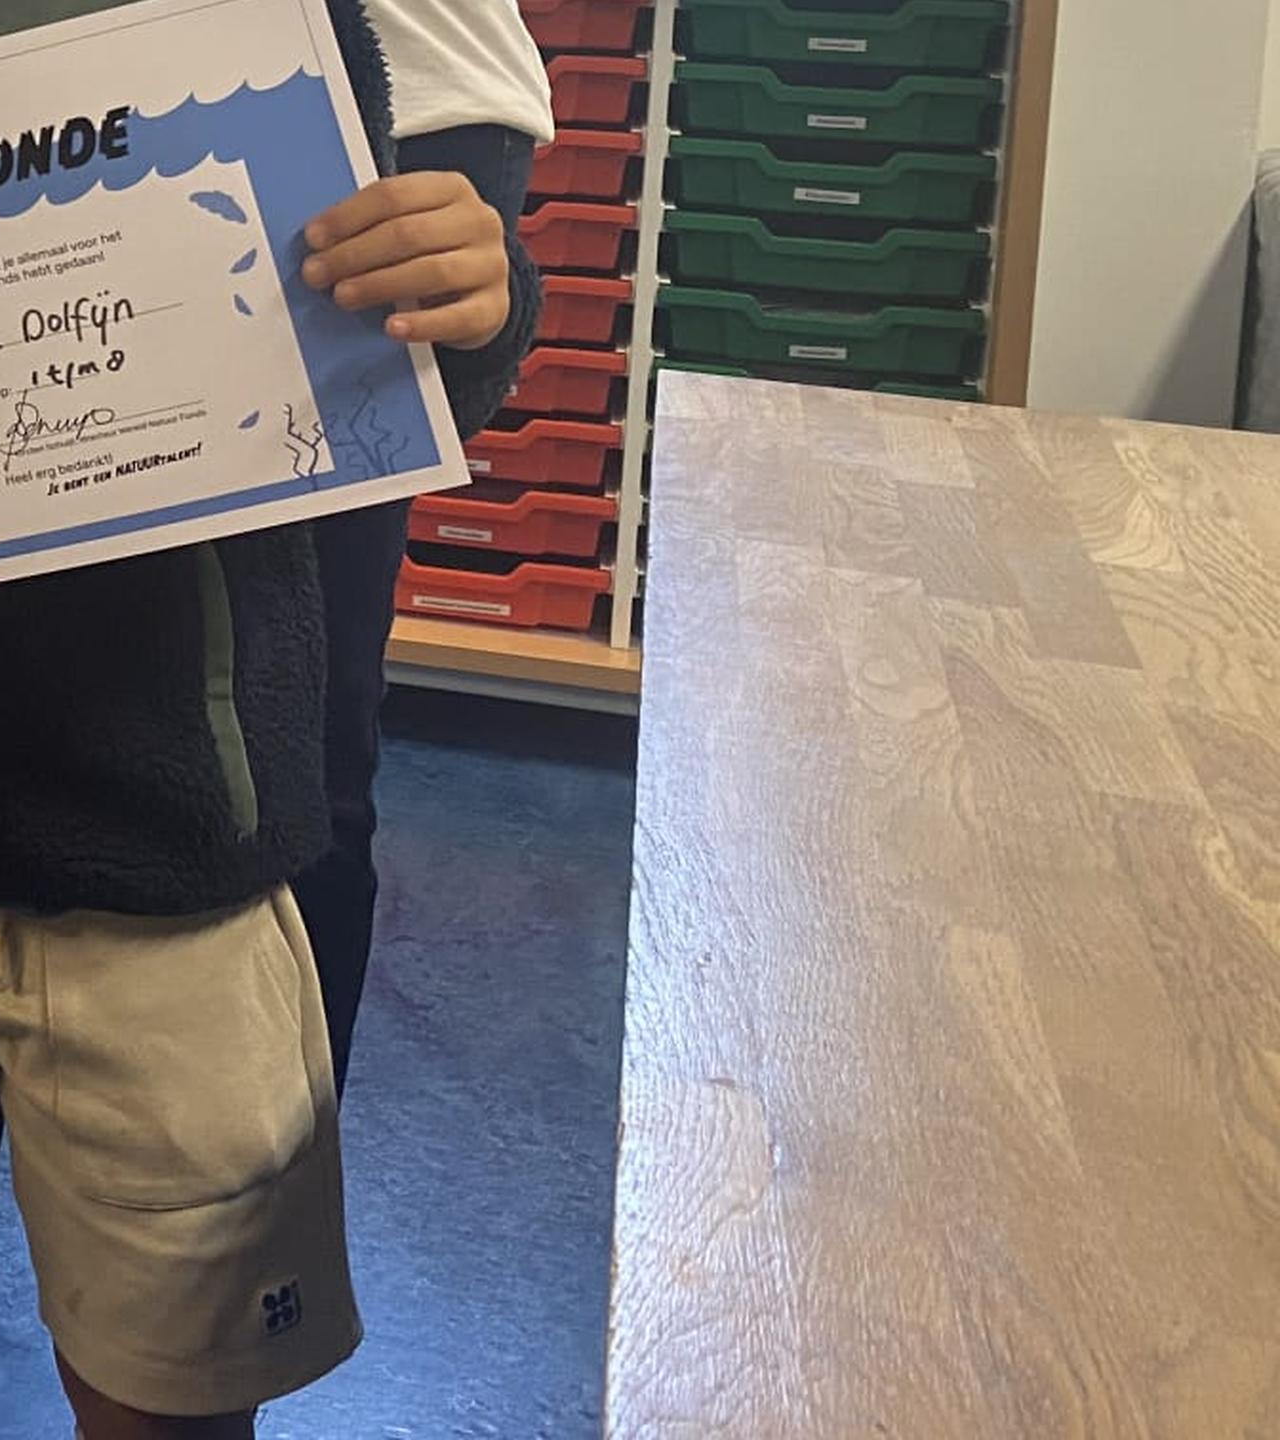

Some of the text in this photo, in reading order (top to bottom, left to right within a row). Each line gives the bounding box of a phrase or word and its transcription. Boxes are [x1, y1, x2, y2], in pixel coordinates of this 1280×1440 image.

[2, 255, 15, 273] je
[17, 243, 70, 265] allemaal
[70, 235, 100, 252] voor
[100, 229, 123, 245] het
[22, 262, 52, 280] hebt
[54, 250, 106, 274] gedaan!
[106, 350, 125, 372] 8
[4, 470, 34, 487] Heel
[36, 466, 58, 482] erg
